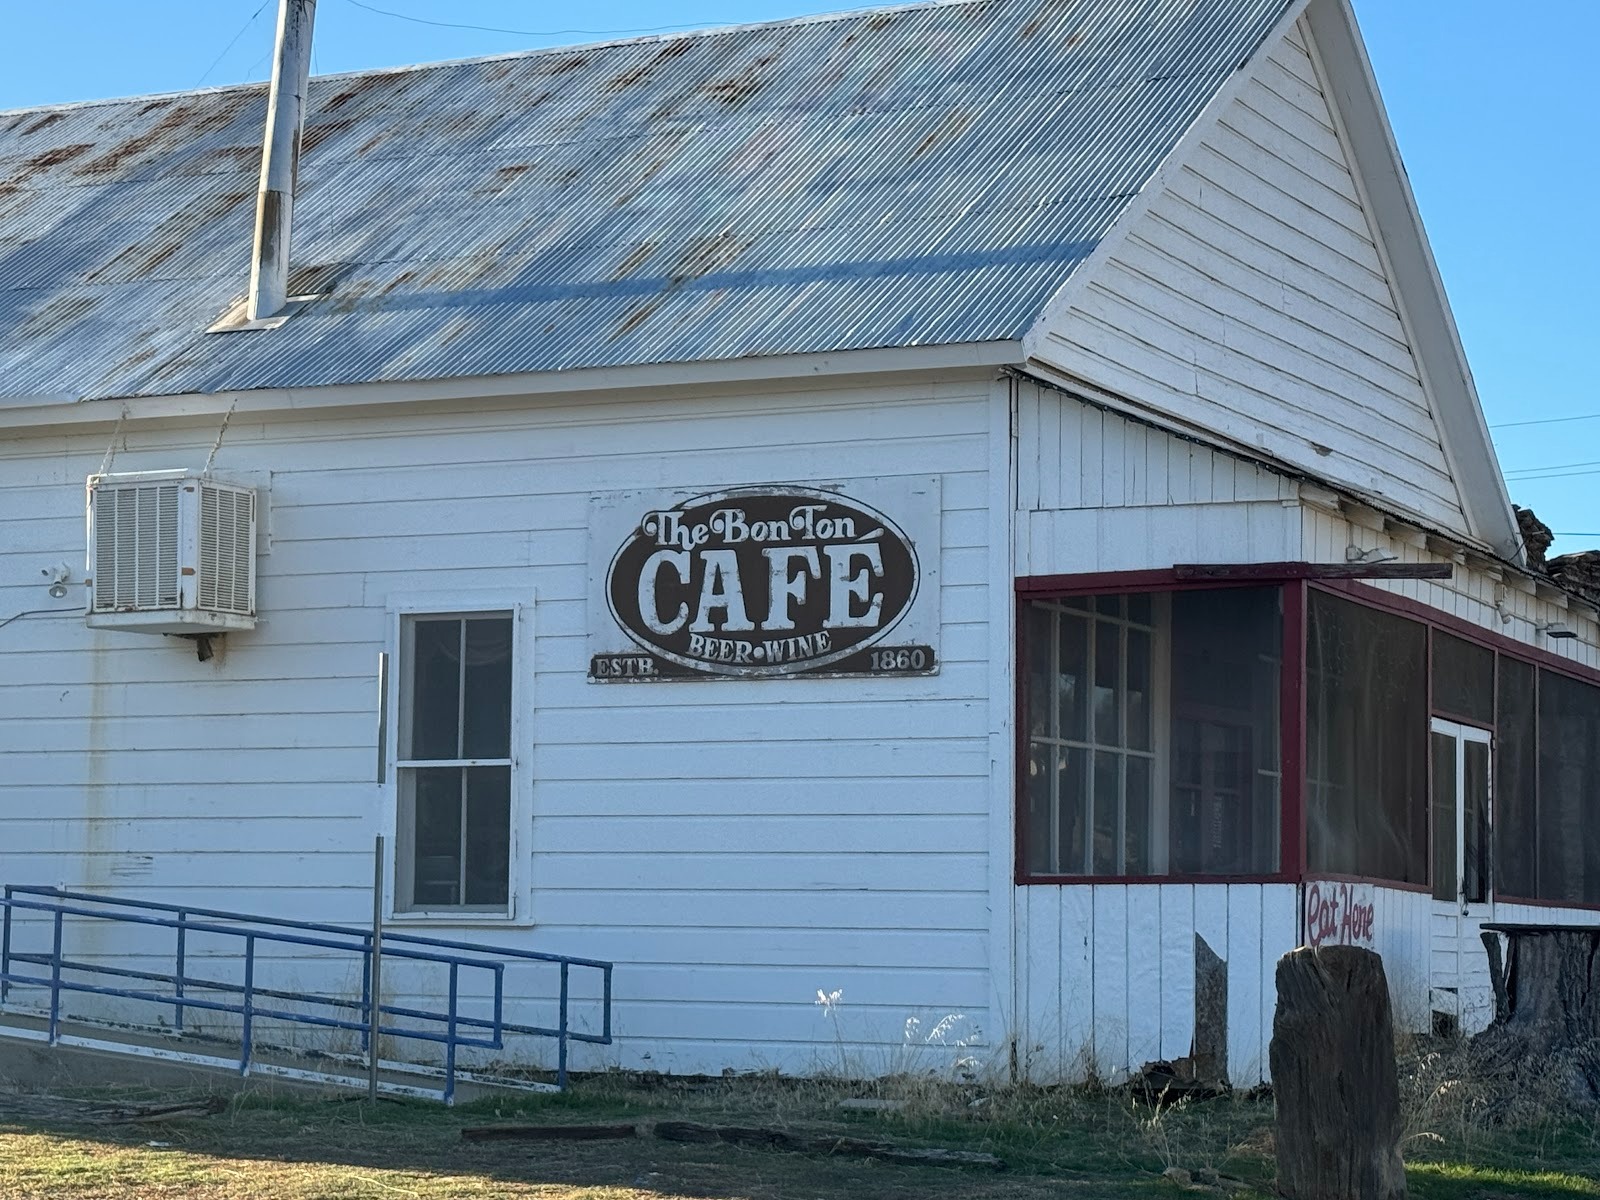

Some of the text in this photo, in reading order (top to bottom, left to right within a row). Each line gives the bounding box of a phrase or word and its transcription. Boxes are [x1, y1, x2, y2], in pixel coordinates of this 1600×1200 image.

[642, 505, 856, 550] The Bon Ton
[870, 649, 926, 671] 1860
[1308, 884, 1374, 947] Eat Here
